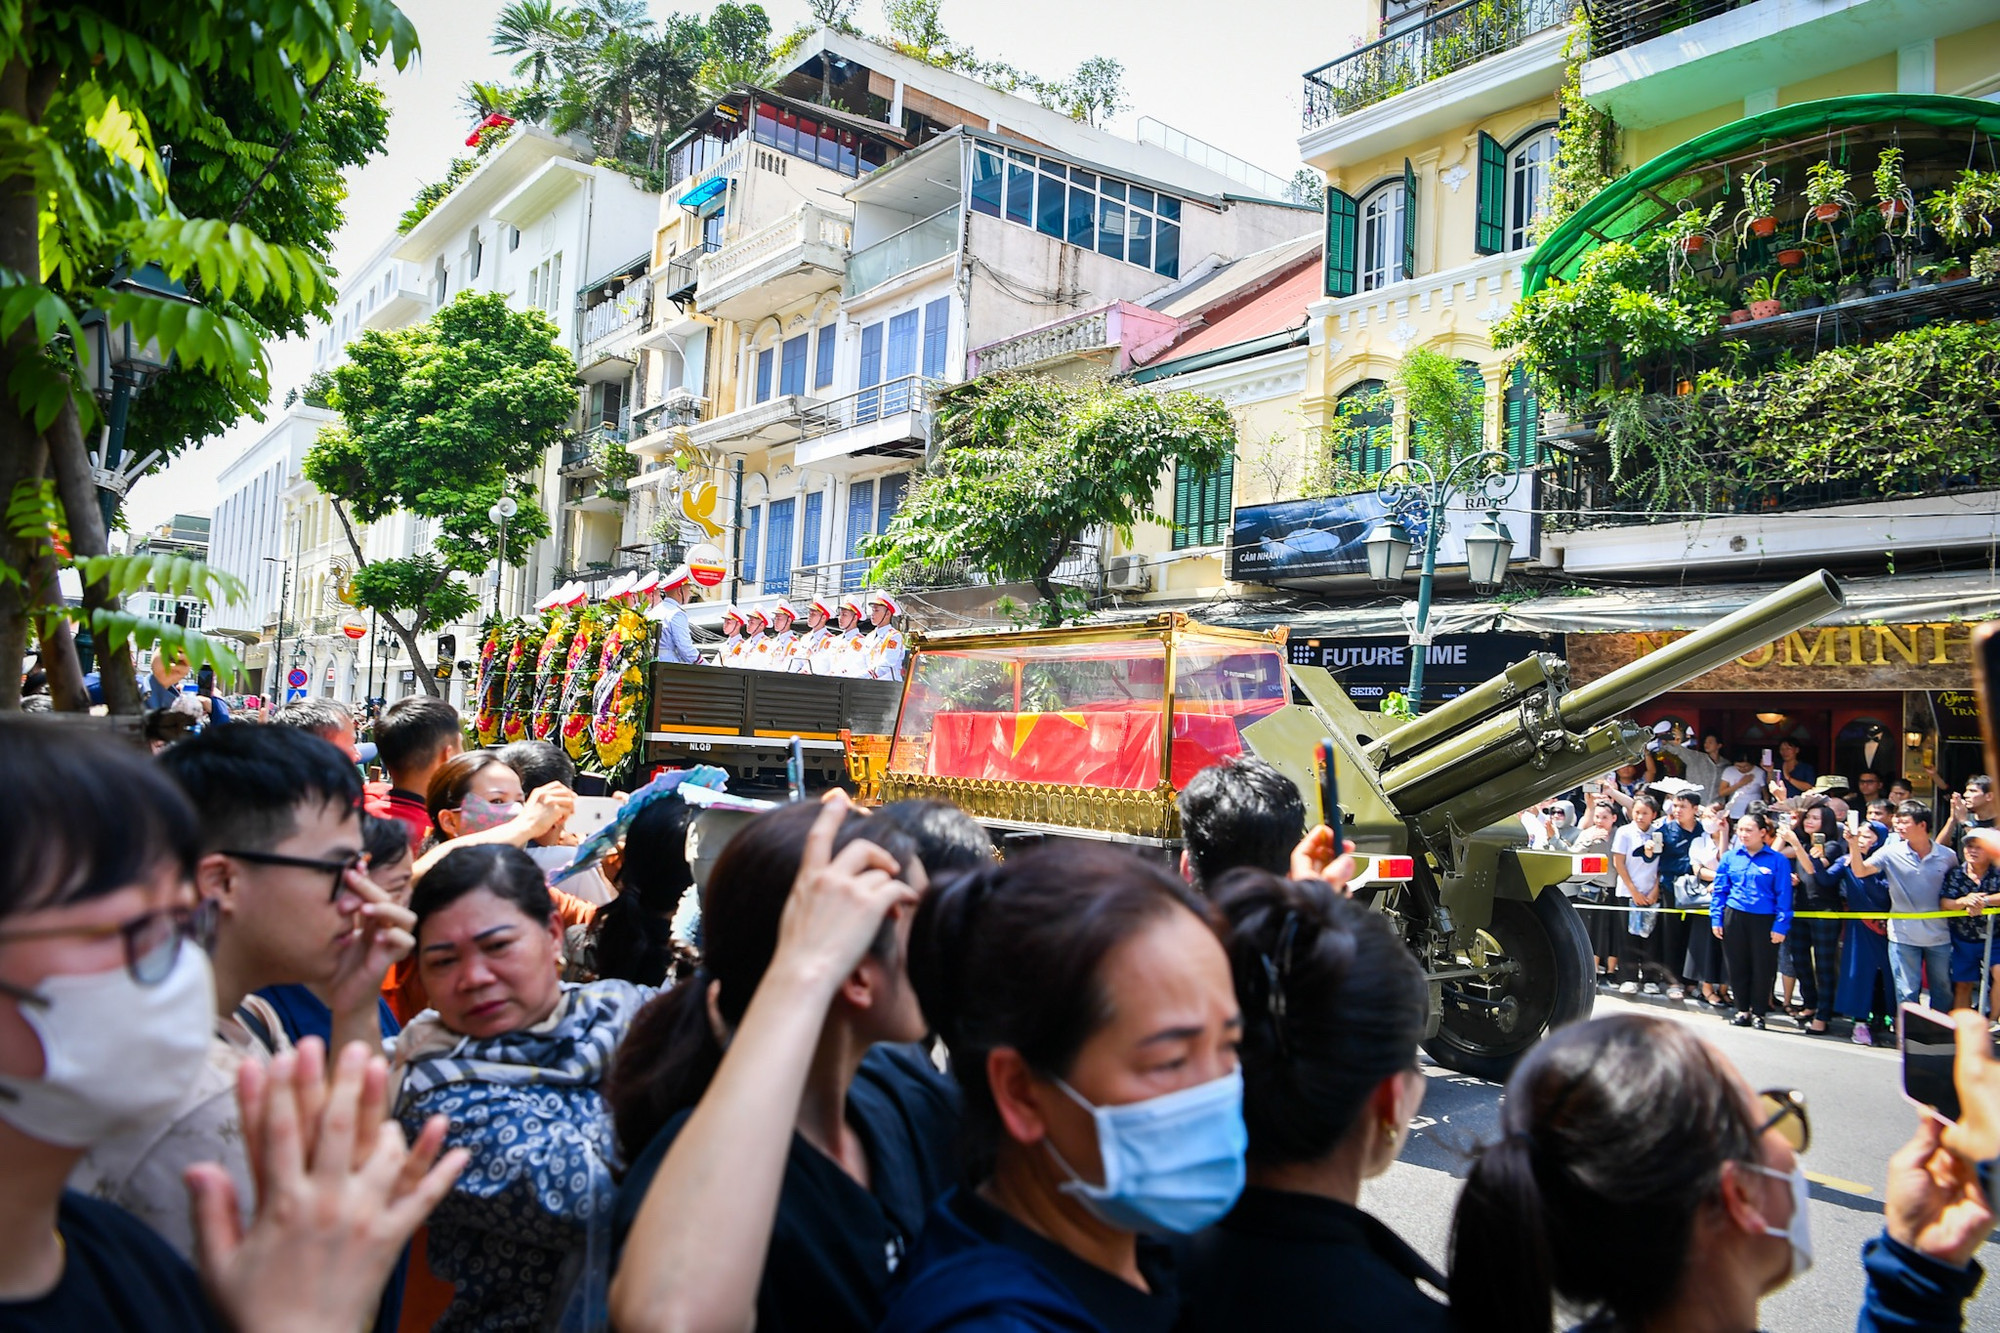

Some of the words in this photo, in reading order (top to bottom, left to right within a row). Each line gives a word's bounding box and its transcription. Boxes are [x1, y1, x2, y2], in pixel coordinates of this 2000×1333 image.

[1322, 646, 1404, 666] FUTURE
[1411, 645, 1468, 665] IME
[1350, 686, 1384, 696] SEIKO
